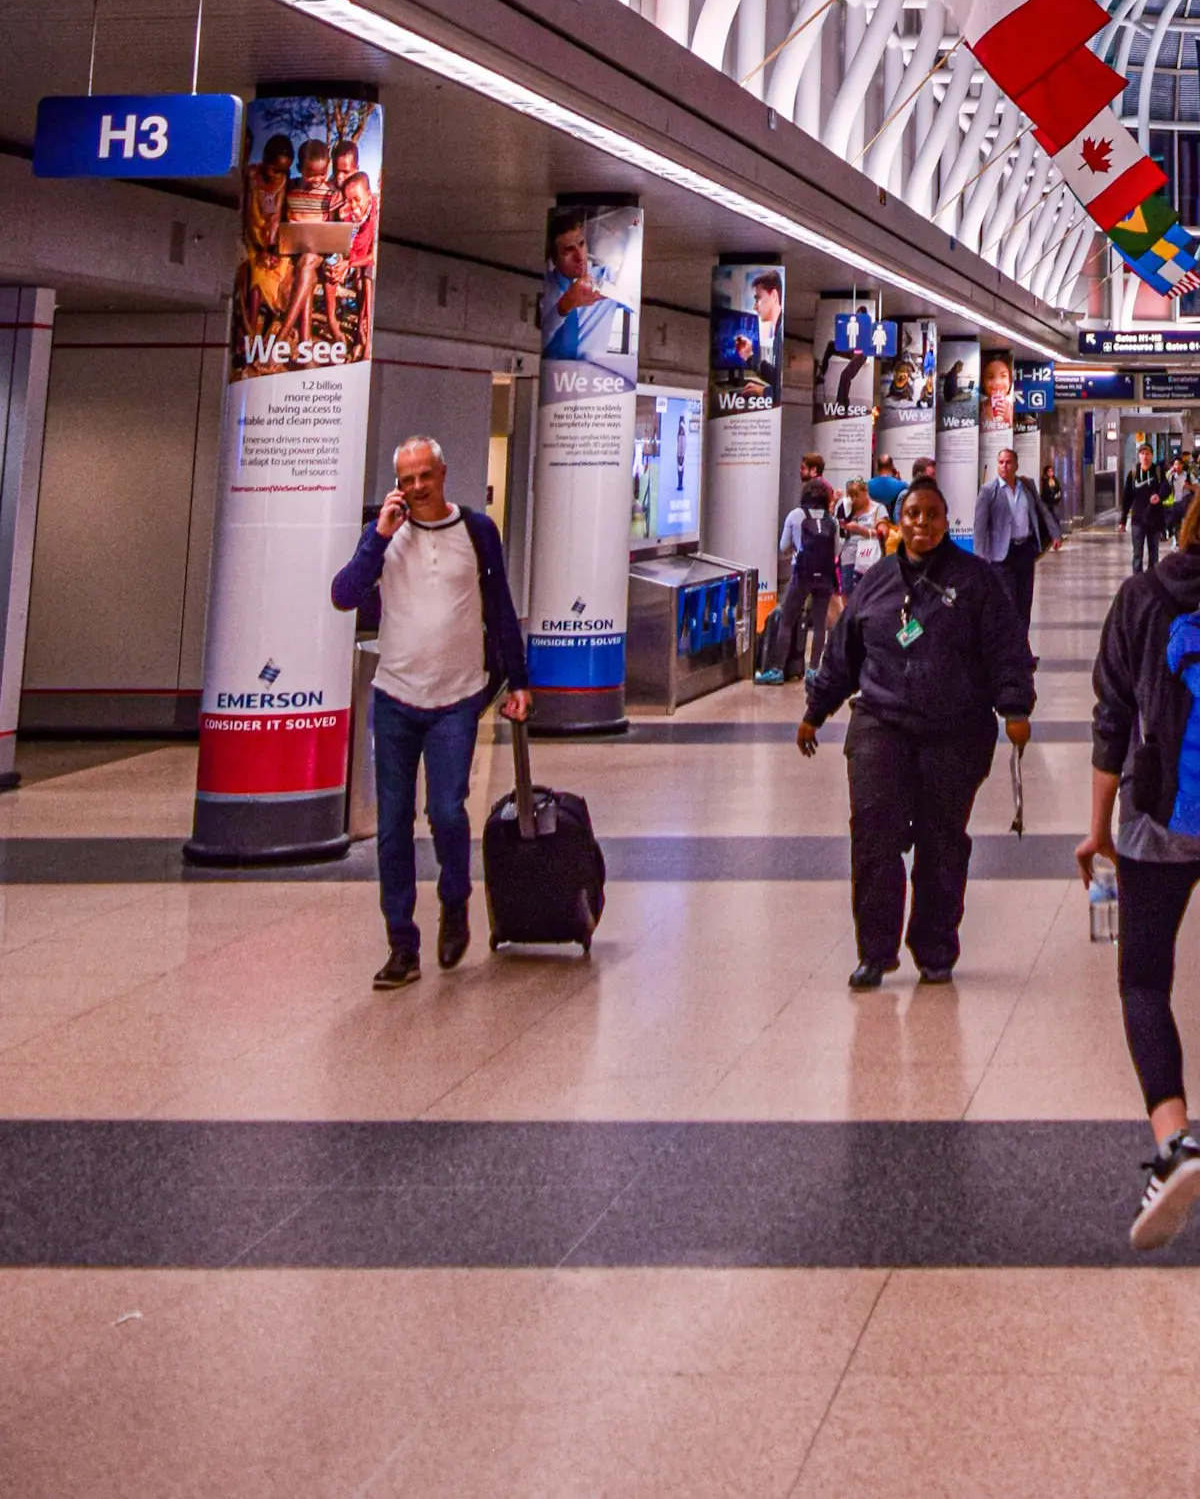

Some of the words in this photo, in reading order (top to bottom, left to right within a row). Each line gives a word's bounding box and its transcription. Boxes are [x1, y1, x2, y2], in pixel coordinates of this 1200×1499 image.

[98, 115, 168, 159] H3
[244, 335, 290, 364] We
[297, 340, 347, 364] see
[1113, 343, 1154, 351] Concourse
[302, 381, 314, 390] 1.2
[317, 381, 342, 390] billion
[553, 372, 587, 393] We
[592, 376, 625, 392] see
[313, 394, 342, 403] people
[719, 393, 745, 410] We
[748, 394, 773, 410] see
[1032, 394, 1043, 405] G
[268, 406, 300, 415] having
[823, 403, 846, 416] We
[848, 404, 867, 416] see
[898, 410, 917, 421] We
[238, 416, 265, 426] eliable
[267, 416, 284, 425] and
[287, 416, 311, 425] clean
[313, 418, 342, 427] power.
[943, 417, 960, 427] We
[961, 418, 976, 427] see
[996, 422, 1010, 430] see
[242, 435, 274, 444] Emerson
[276, 435, 300, 443] drives
[322, 437, 340, 445] ways
[255, 446, 287, 456] existing
[289, 448, 314, 456] power
[317, 446, 340, 455] plants
[248, 457, 269, 467] adapt
[271, 457, 280, 465] to
[298, 457, 338, 465] renewable
[292, 468, 308, 476] fuel
[542, 619, 614, 631] EMERSON
[531, 637, 575, 647] CONSIDER
[577, 638, 588, 646] IT
[590, 636, 622, 646] SOLVED
[217, 690, 323, 709] EMERSON
[205, 718, 261, 731] CONSIDER
[266, 719, 282, 730] IT
[285, 716, 336, 731] SOLVED
